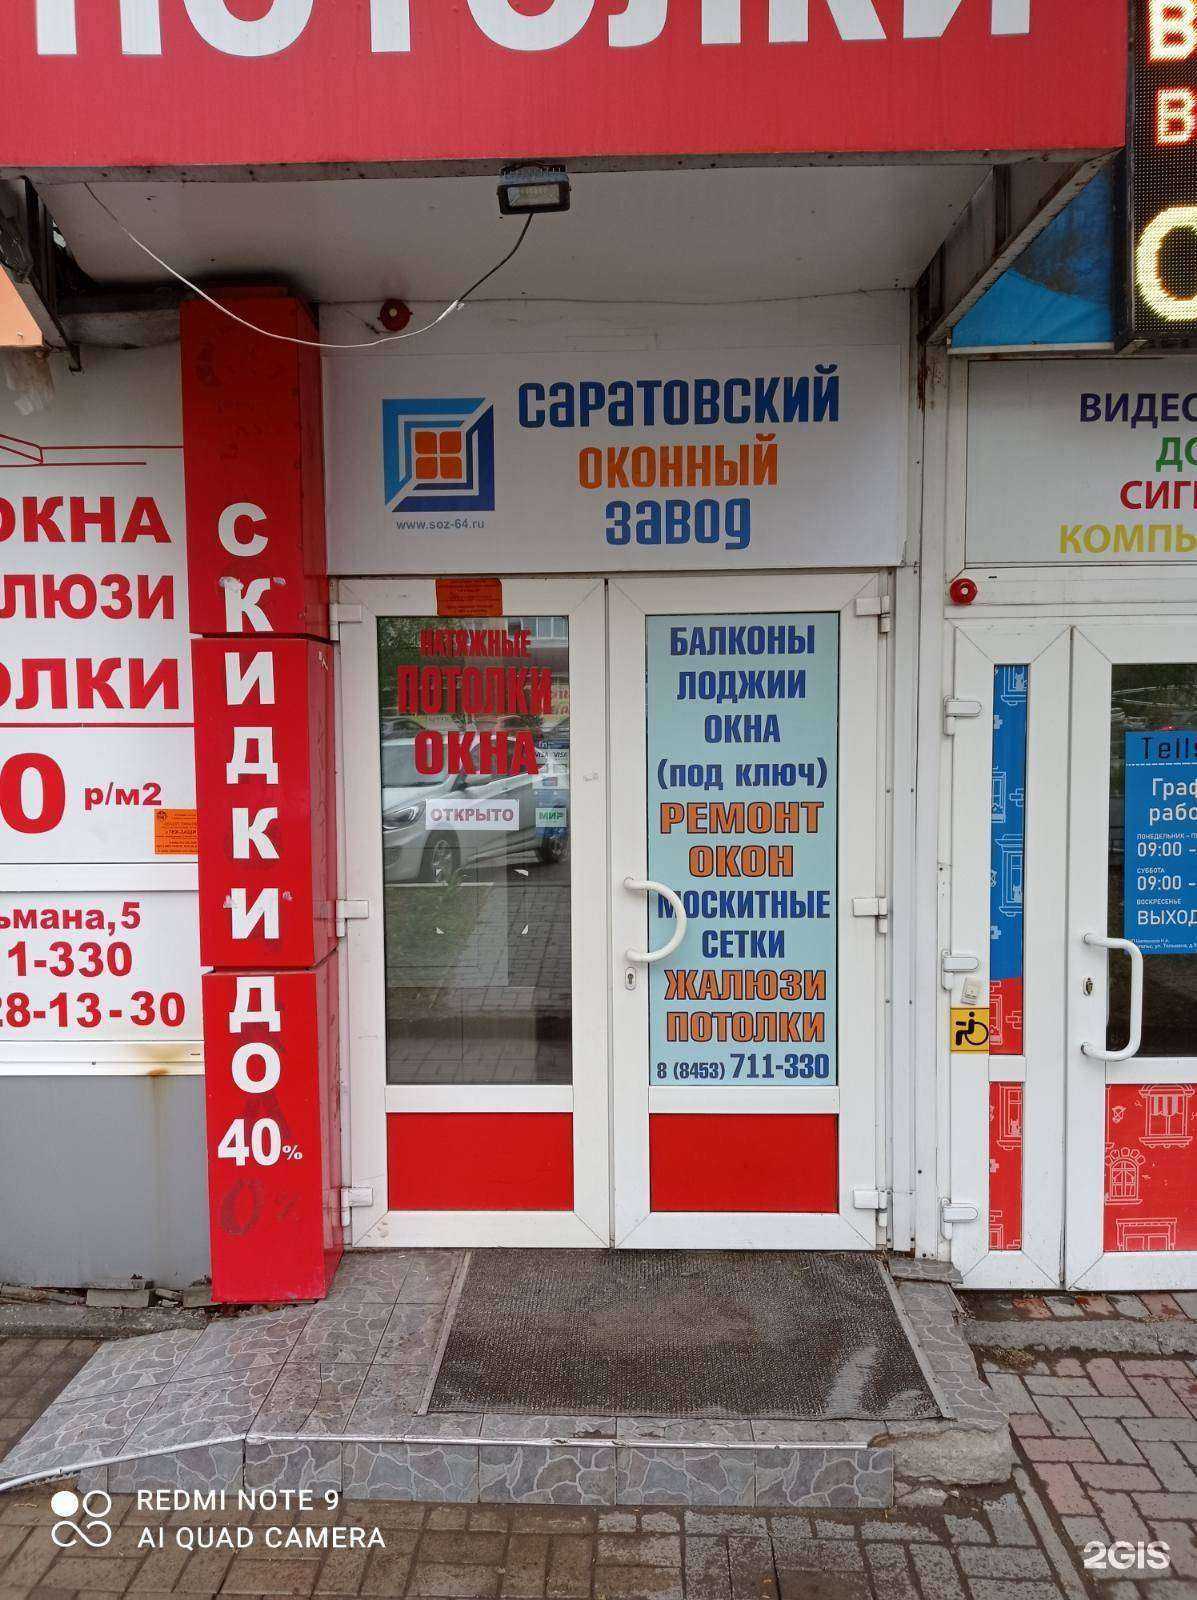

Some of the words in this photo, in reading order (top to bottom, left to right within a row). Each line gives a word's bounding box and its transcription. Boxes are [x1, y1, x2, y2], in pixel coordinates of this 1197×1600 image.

[579, 433, 778, 490] ОКОННЫЙ
[1120, 480, 1197, 510] СИГ
[396, 518, 485, 530] www.soz-64.ru
[419, 629, 532, 657] НАТЯЖНЫЕ
[670, 625, 815, 656] БАЛКОНЫ
[0, 657, 179, 710] ЛКИ
[397, 665, 553, 716] ПОТОЛКИ
[676, 669, 806, 704] ЛОДЖИИ
[217, 502, 281, 940] СКИДКИ
[704, 714, 781, 744] ОКНА
[414, 731, 540, 775] ОКНА
[1141, 736, 1197, 760] Tell
[657, 758, 723, 791] (под
[735, 757, 828, 789] ключ)
[84, 782, 162, 811] р/м2
[430, 807, 515, 823] ОТКРЫТО
[659, 801, 824, 835] РЕМОНТ
[688, 845, 794, 878] ОКОН
[1137, 841, 1182, 857] 09:00
[1137, 875, 1182, 891] 09:00
[7, 940, 133, 977] 1-330
[702, 929, 785, 959] СЕТКИ
[664, 969, 827, 1001] ЖАЛЮЗИ
[0, 990, 186, 1028] 8-13-30
[667, 1012, 825, 1042] ПОТОЛКИ
[656, 1062, 667, 1079] 8
[673, 1062, 725, 1080] (8453)
[730, 1053, 829, 1079] 711-330
[217, 1117, 304, 1167] 40%
